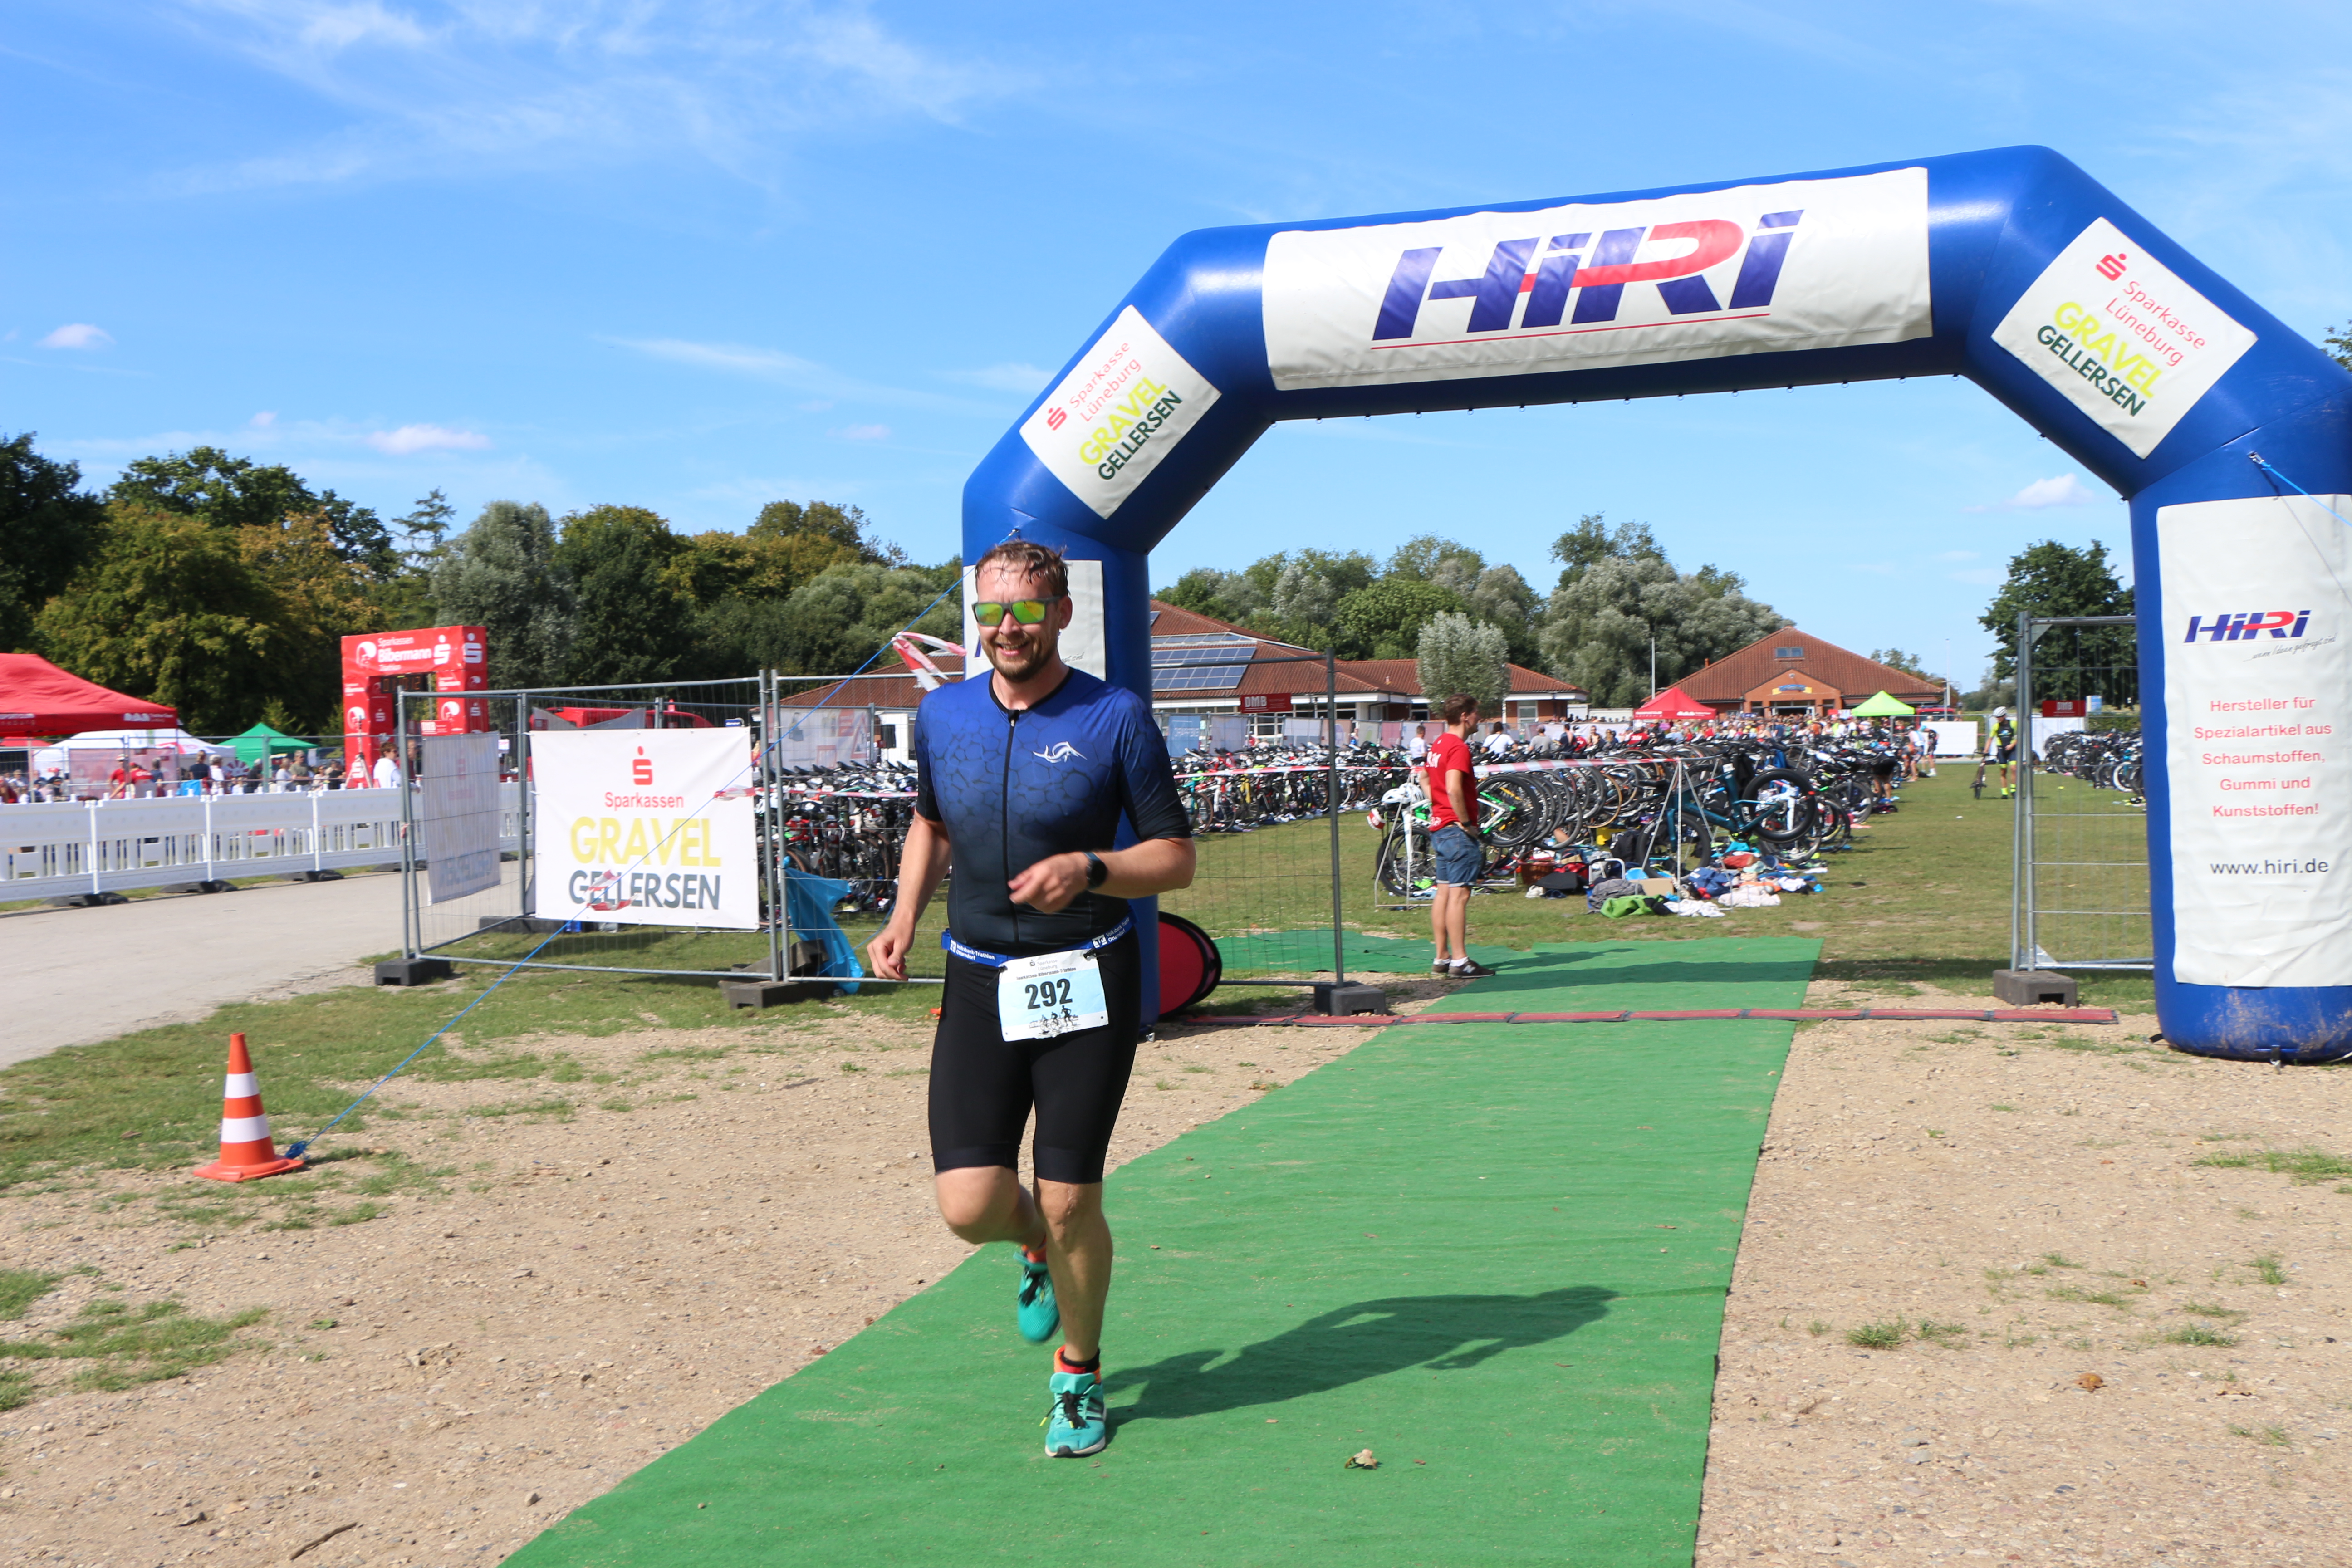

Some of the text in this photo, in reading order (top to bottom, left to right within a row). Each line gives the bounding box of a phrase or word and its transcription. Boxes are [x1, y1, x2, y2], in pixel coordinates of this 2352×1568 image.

[2122, 280, 2206, 349] Sparkasse
[2105, 297, 2185, 367] Lüneburg
[2054, 301, 2162, 398] GRAVEL
[1069, 343, 1130, 408] Sparkasse
[2037, 325, 2146, 417] GELLERSEN
[1079, 358, 1142, 421] Lüneburg
[1079, 377, 1167, 465] GRAVEL
[1098, 390, 1182, 480] GELLERSEN
[378, 637, 414, 647] Sparkassen
[378, 647, 431, 662] Bibermann
[2210, 696, 2316, 712] Hersteller für
[2194, 725, 2332, 741] Spezialartikel aus
[2202, 750, 2326, 765] Schaumstoffen,
[2220, 777, 2311, 790] Gummi und
[605, 792, 684, 811] Sparkassen
[2213, 804, 2319, 817] Kunststoffen!
[570, 816, 721, 867] GRAVEL
[2210, 858, 2329, 875] www.hiri.de
[956, 944, 995, 960] Volksbank-Triathlon
[1025, 978, 1073, 1009] 292
